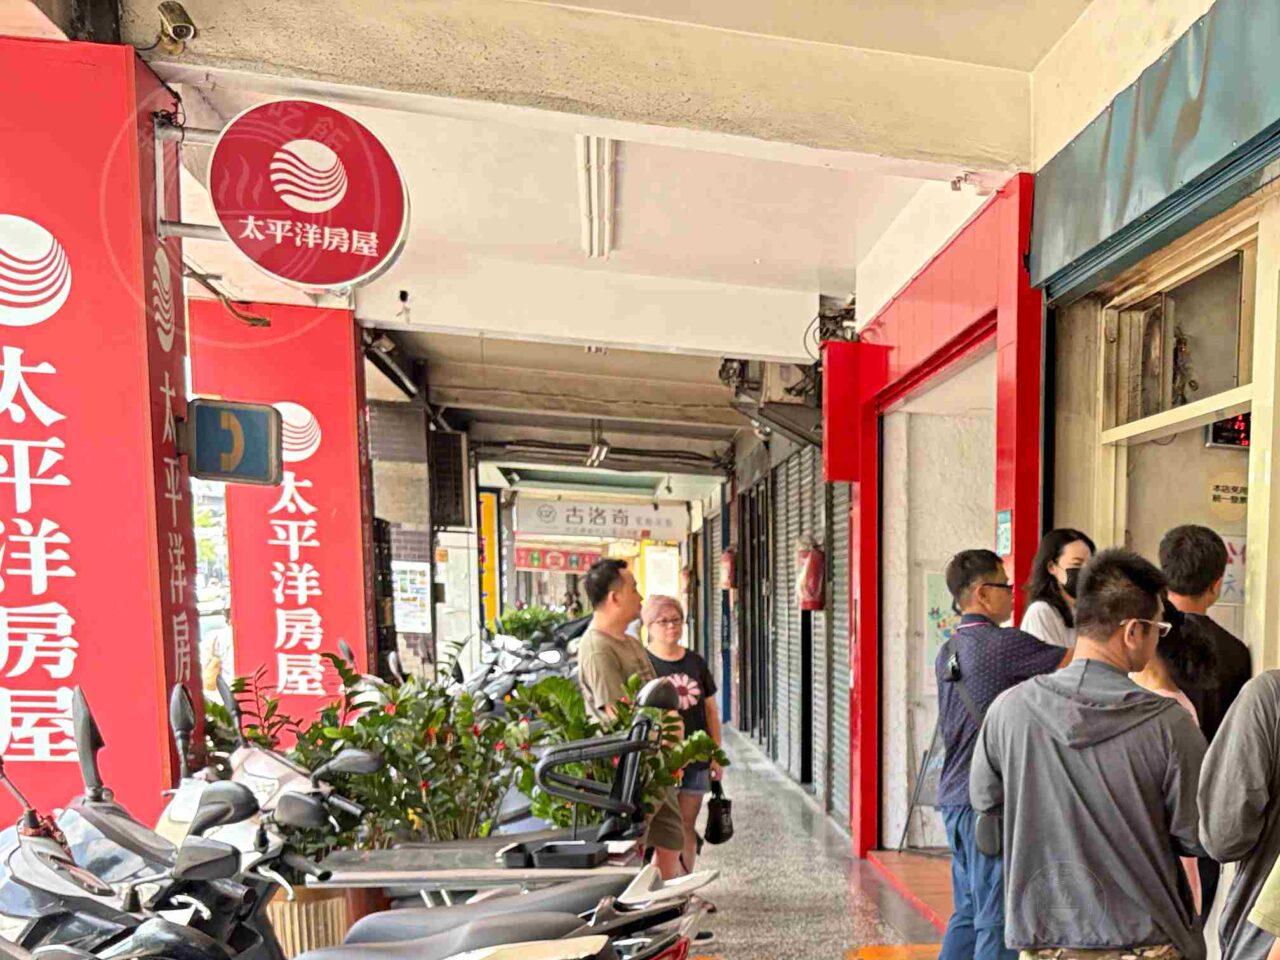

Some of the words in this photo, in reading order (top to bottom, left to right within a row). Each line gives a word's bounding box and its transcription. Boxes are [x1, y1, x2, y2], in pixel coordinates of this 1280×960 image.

[238, 214, 380, 257] 太平洋房屋
[159, 371, 192, 684] 太平洋房
[267, 471, 326, 696] 太平洋房屋
